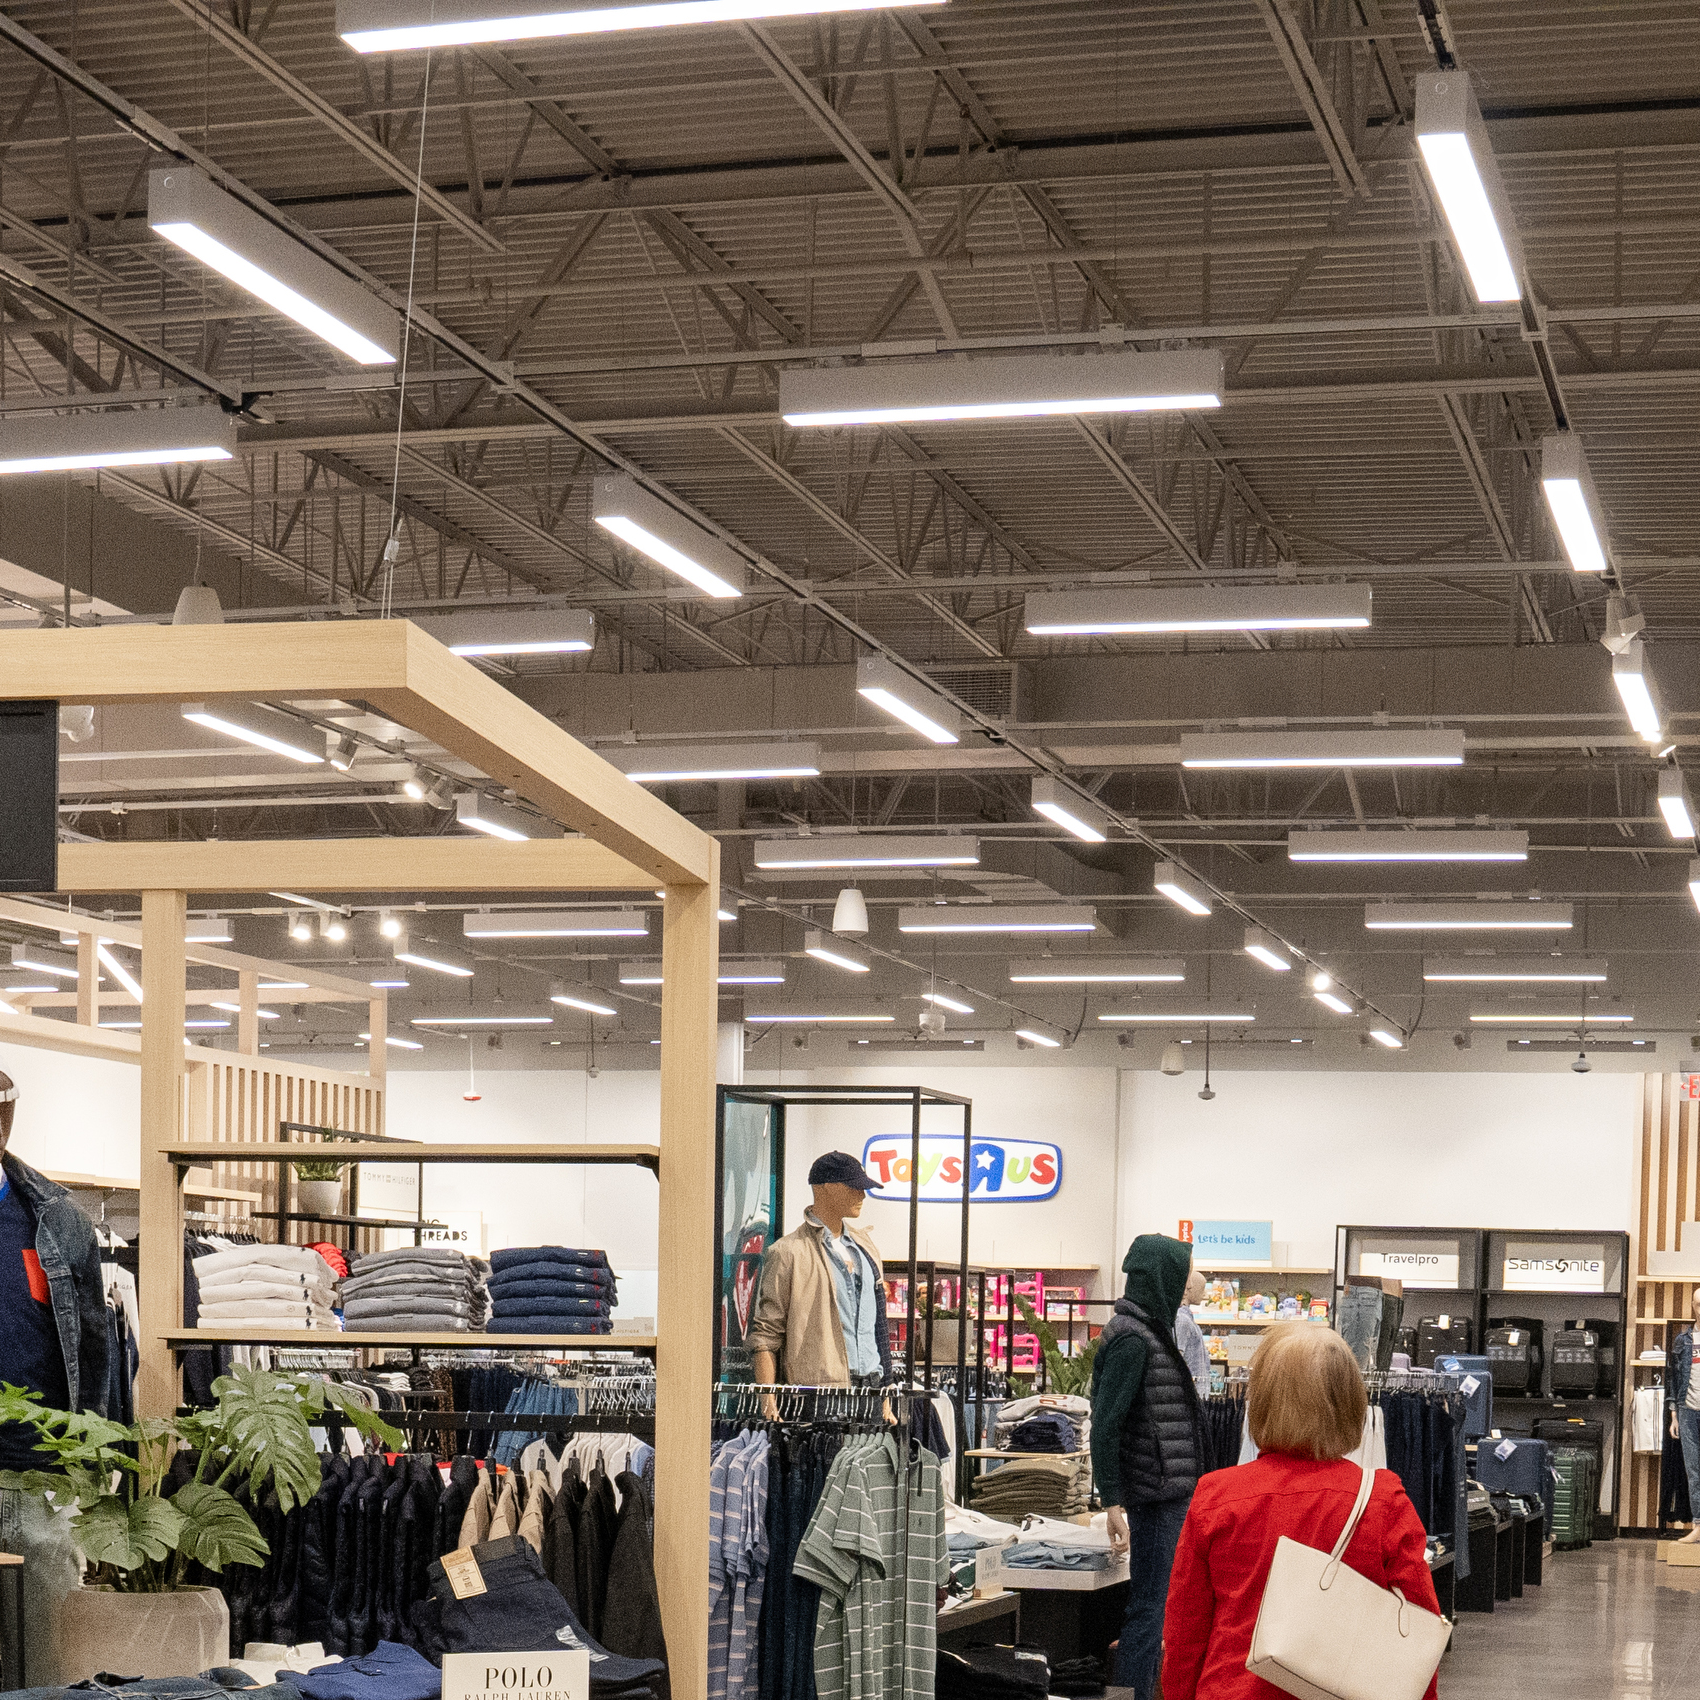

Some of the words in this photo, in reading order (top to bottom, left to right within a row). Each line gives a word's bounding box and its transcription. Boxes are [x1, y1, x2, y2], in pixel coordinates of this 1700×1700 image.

[363, 1171, 386, 1183] TOMMY
[412, 1230, 468, 1242] HREADS
[1220, 1234, 1233, 1244] be
[1235, 1233, 1256, 1245] kids
[1381, 1252, 1439, 1267] Travelpro
[1508, 1257, 1600, 1273] Samsonite
[484, 1665, 553, 1689] POLO
